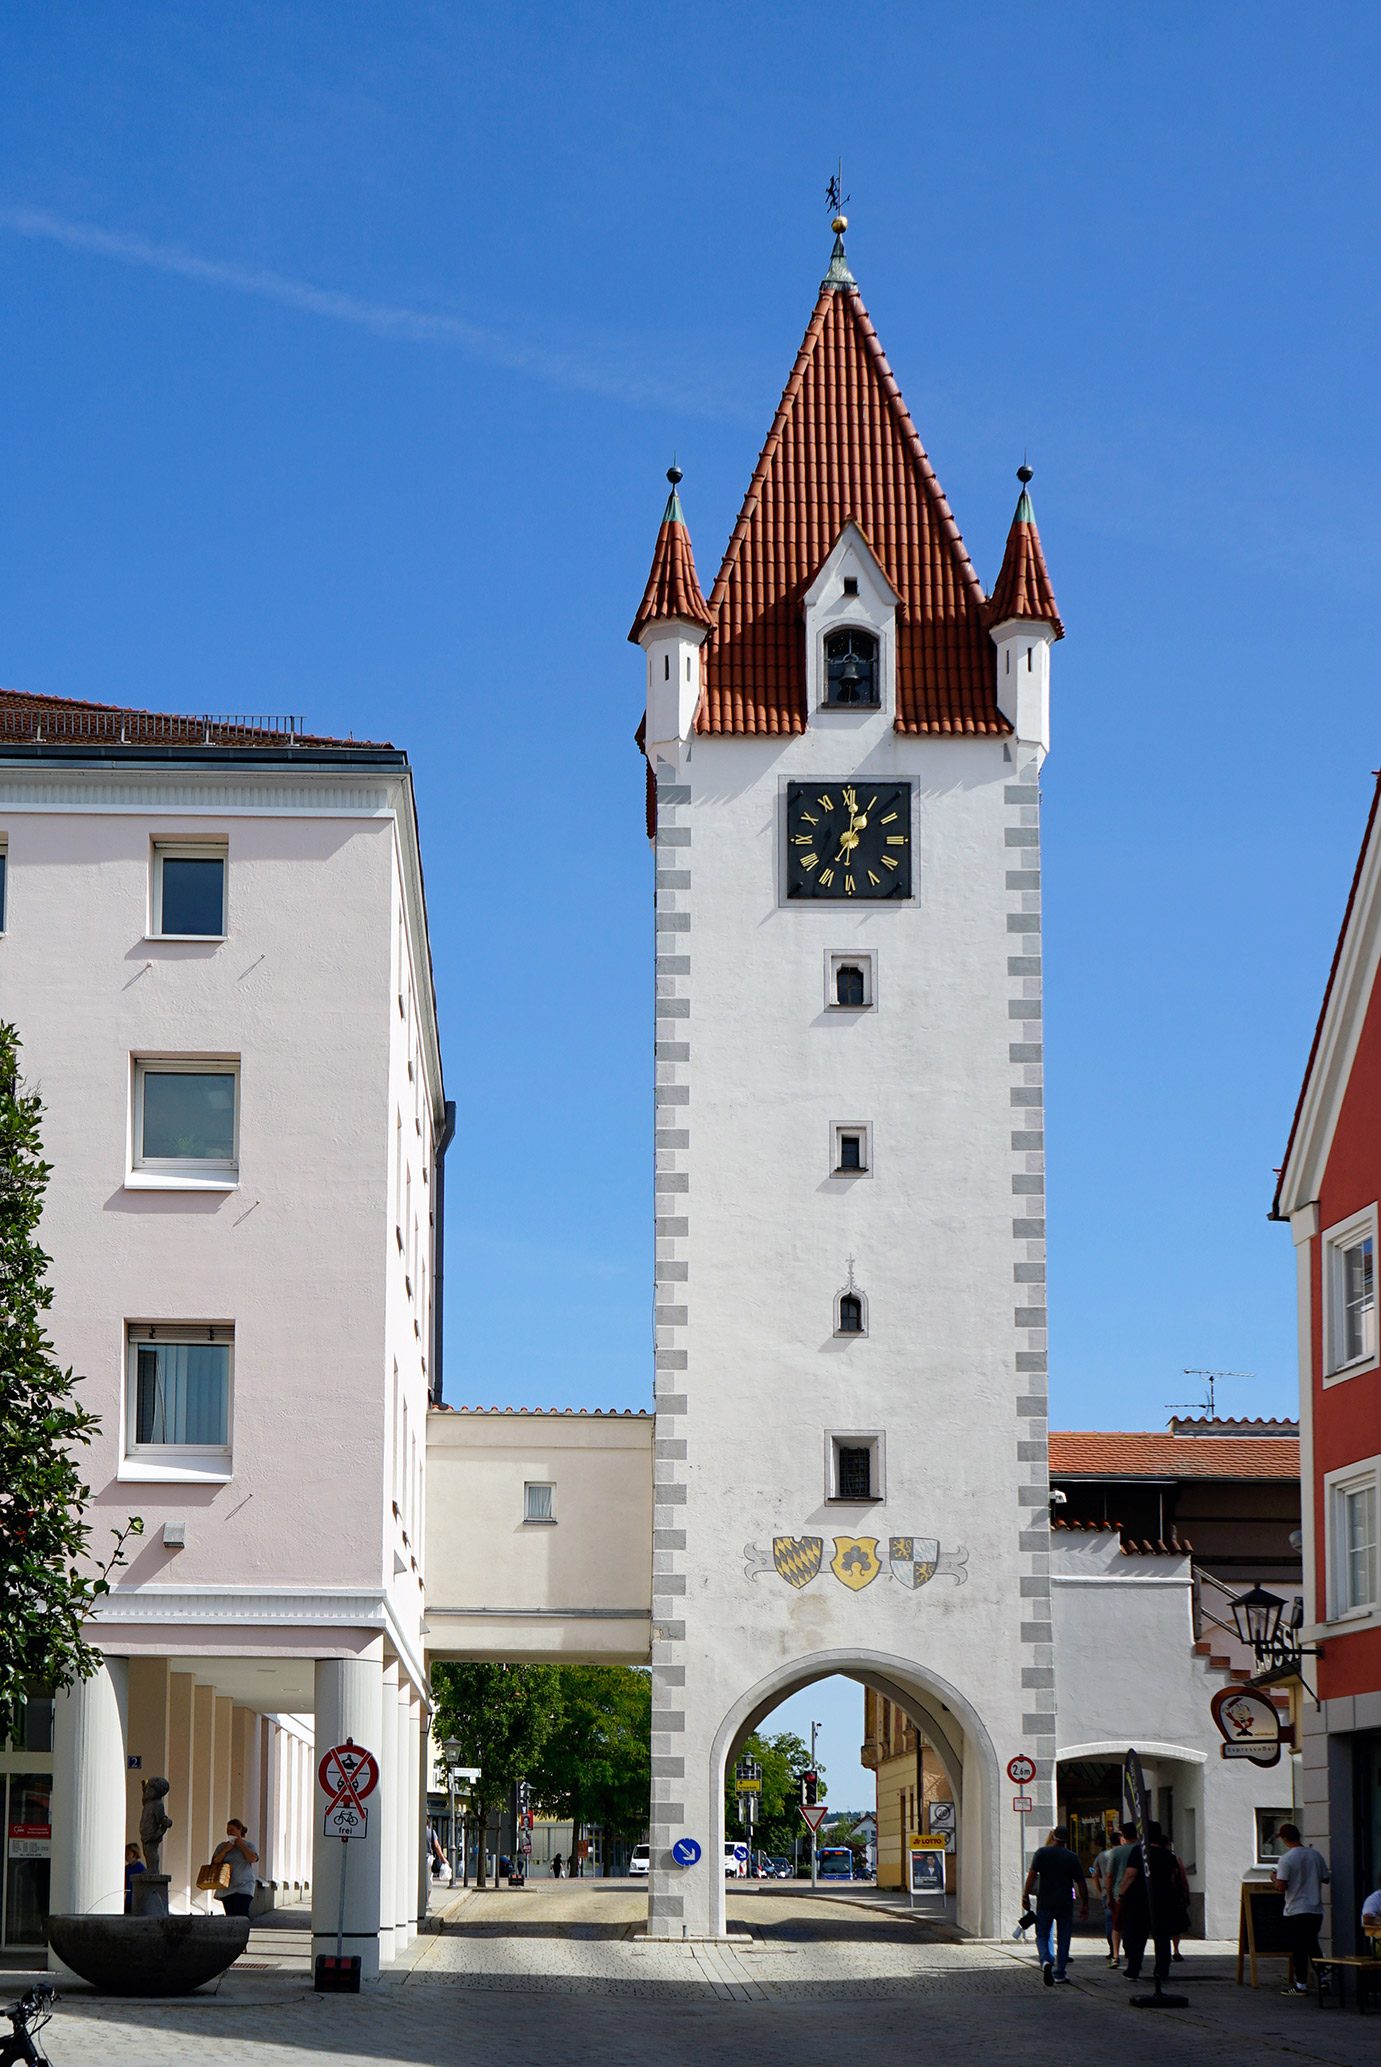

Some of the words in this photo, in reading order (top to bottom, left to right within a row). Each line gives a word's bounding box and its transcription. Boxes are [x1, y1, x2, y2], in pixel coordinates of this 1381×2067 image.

[818, 794, 834, 813] XI
[801, 812, 819, 826] X
[880, 812, 898, 824] II
[795, 834, 812, 844] IX
[886, 835, 904, 844] III
[845, 875, 856, 891] VI
[131, 1757, 138, 1768] 2
[338, 1826, 352, 1835] frei
